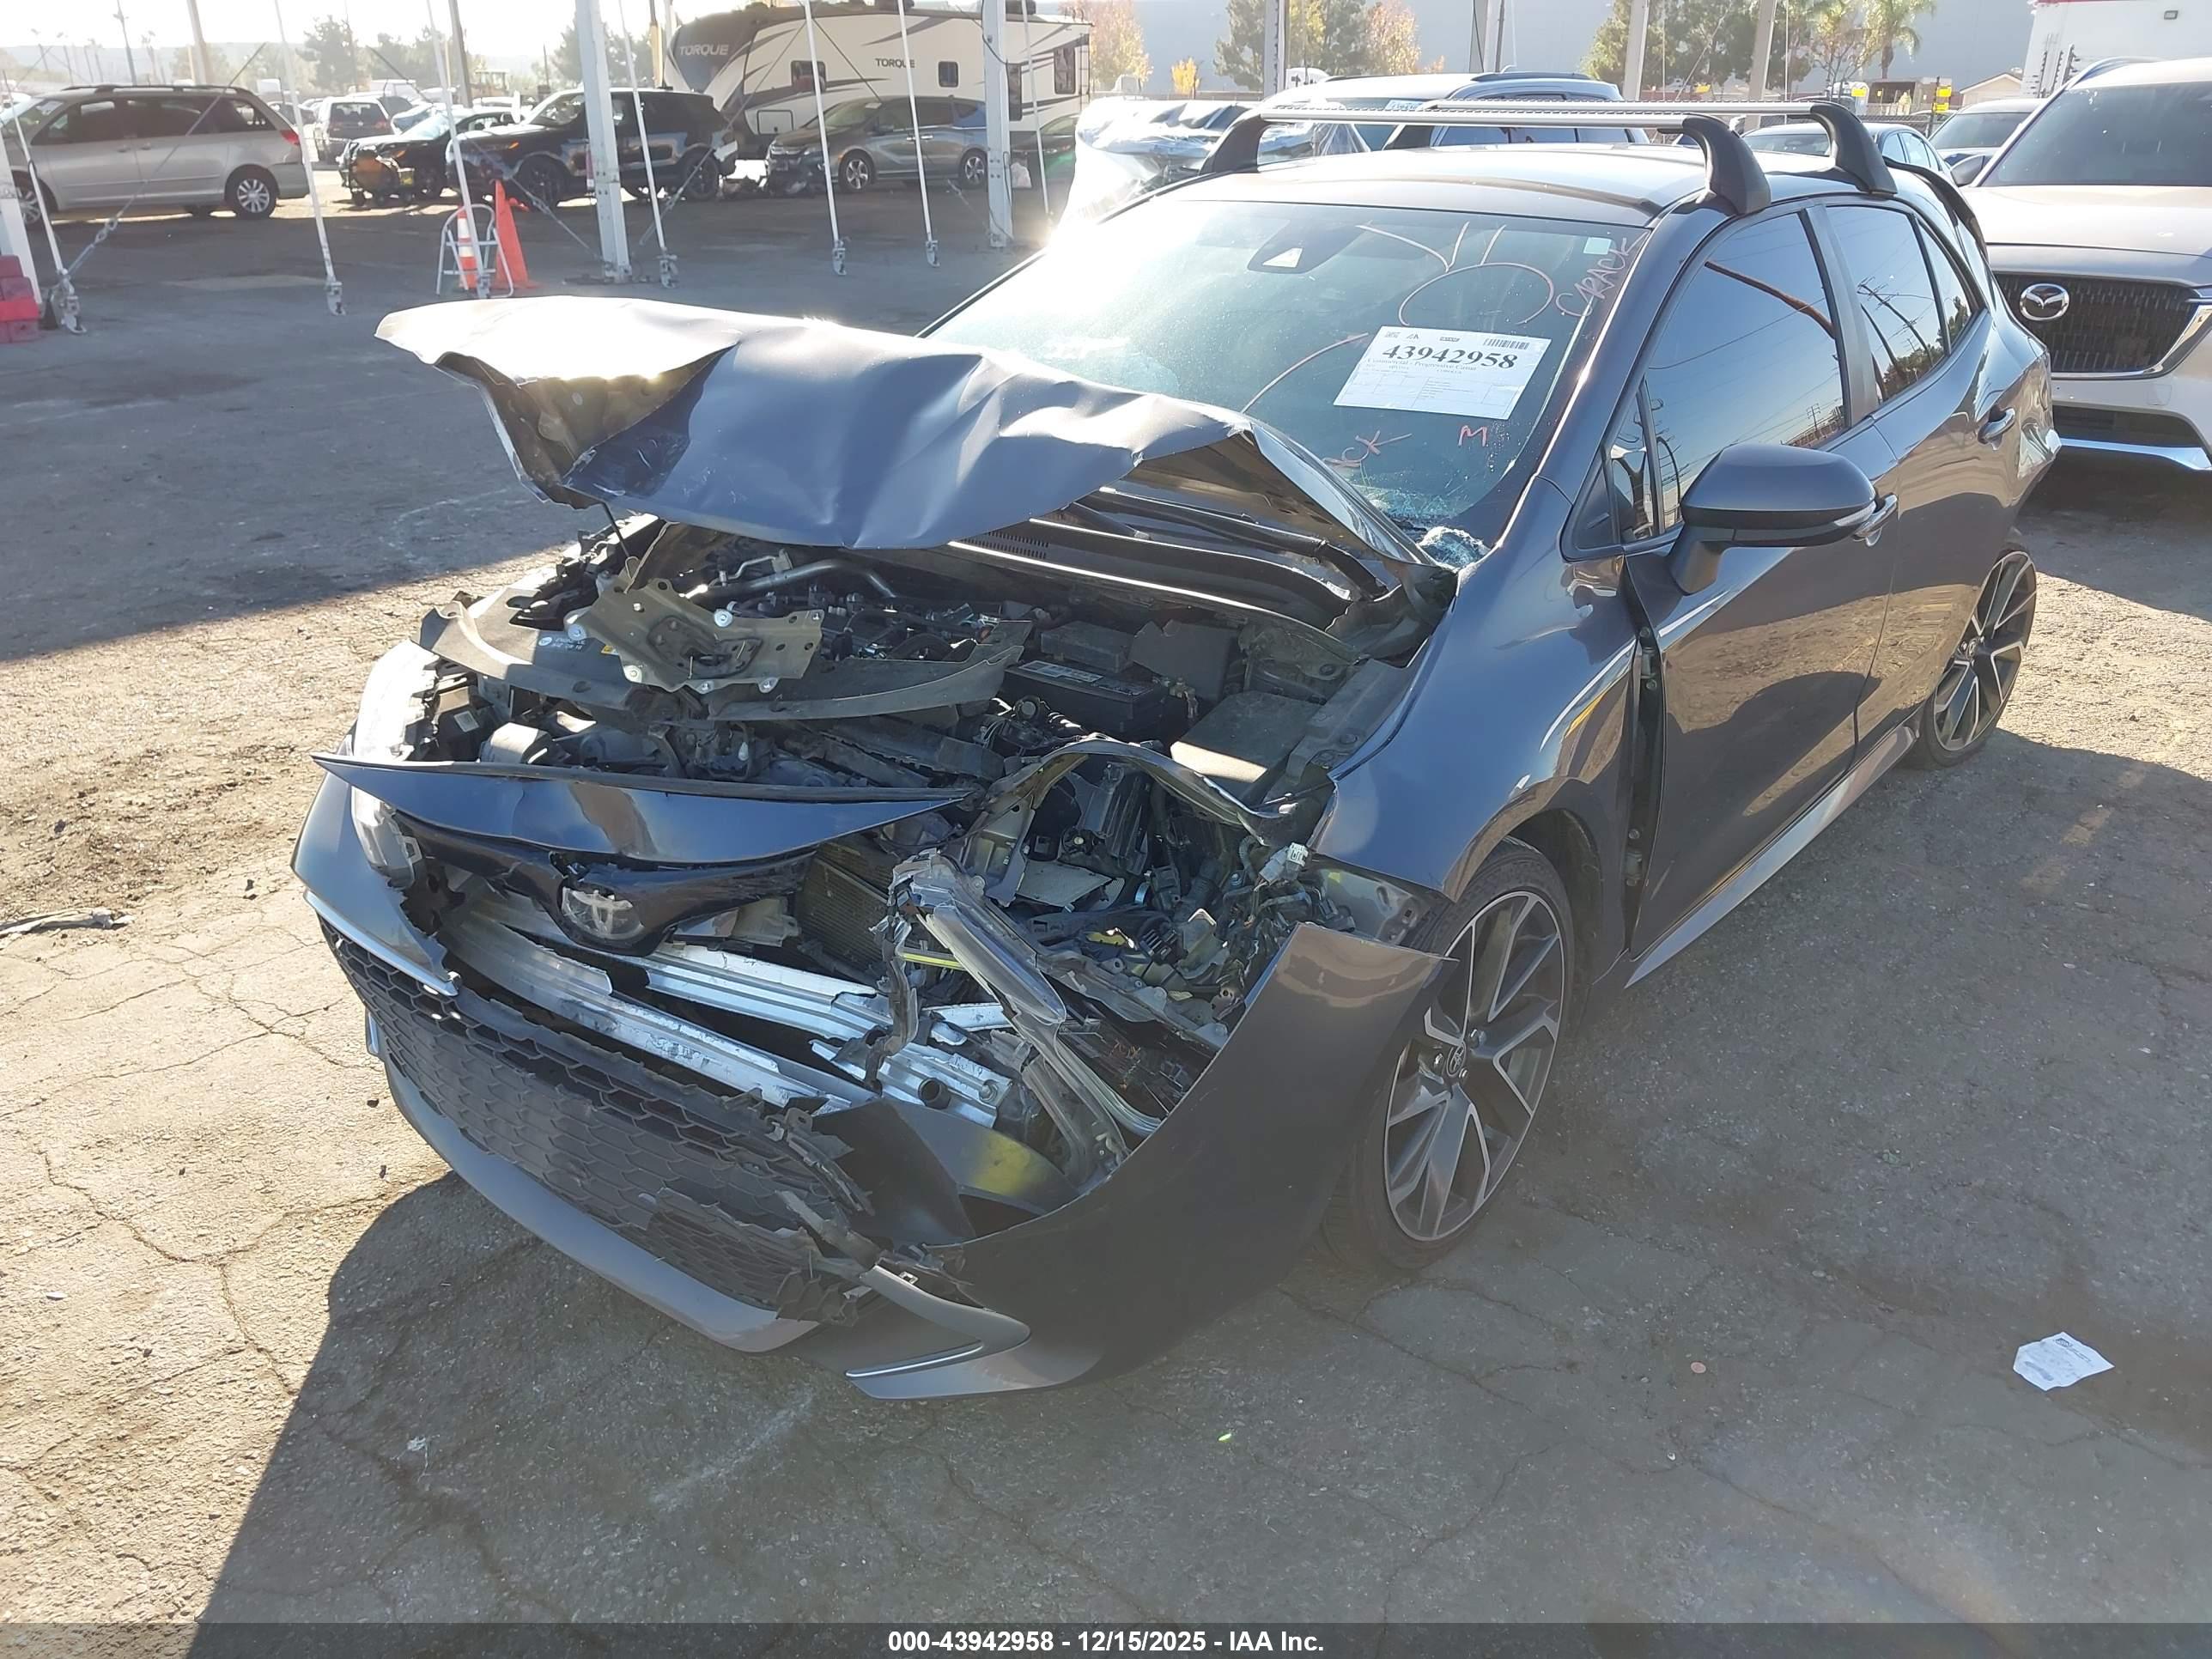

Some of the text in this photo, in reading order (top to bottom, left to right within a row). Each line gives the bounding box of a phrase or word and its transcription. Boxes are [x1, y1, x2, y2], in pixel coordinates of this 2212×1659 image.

[679, 44, 729, 57] TORQUE
[875, 58, 915, 69] TORQUE
[1382, 343, 1518, 370] 43942958
[1457, 425, 1487, 447] M
